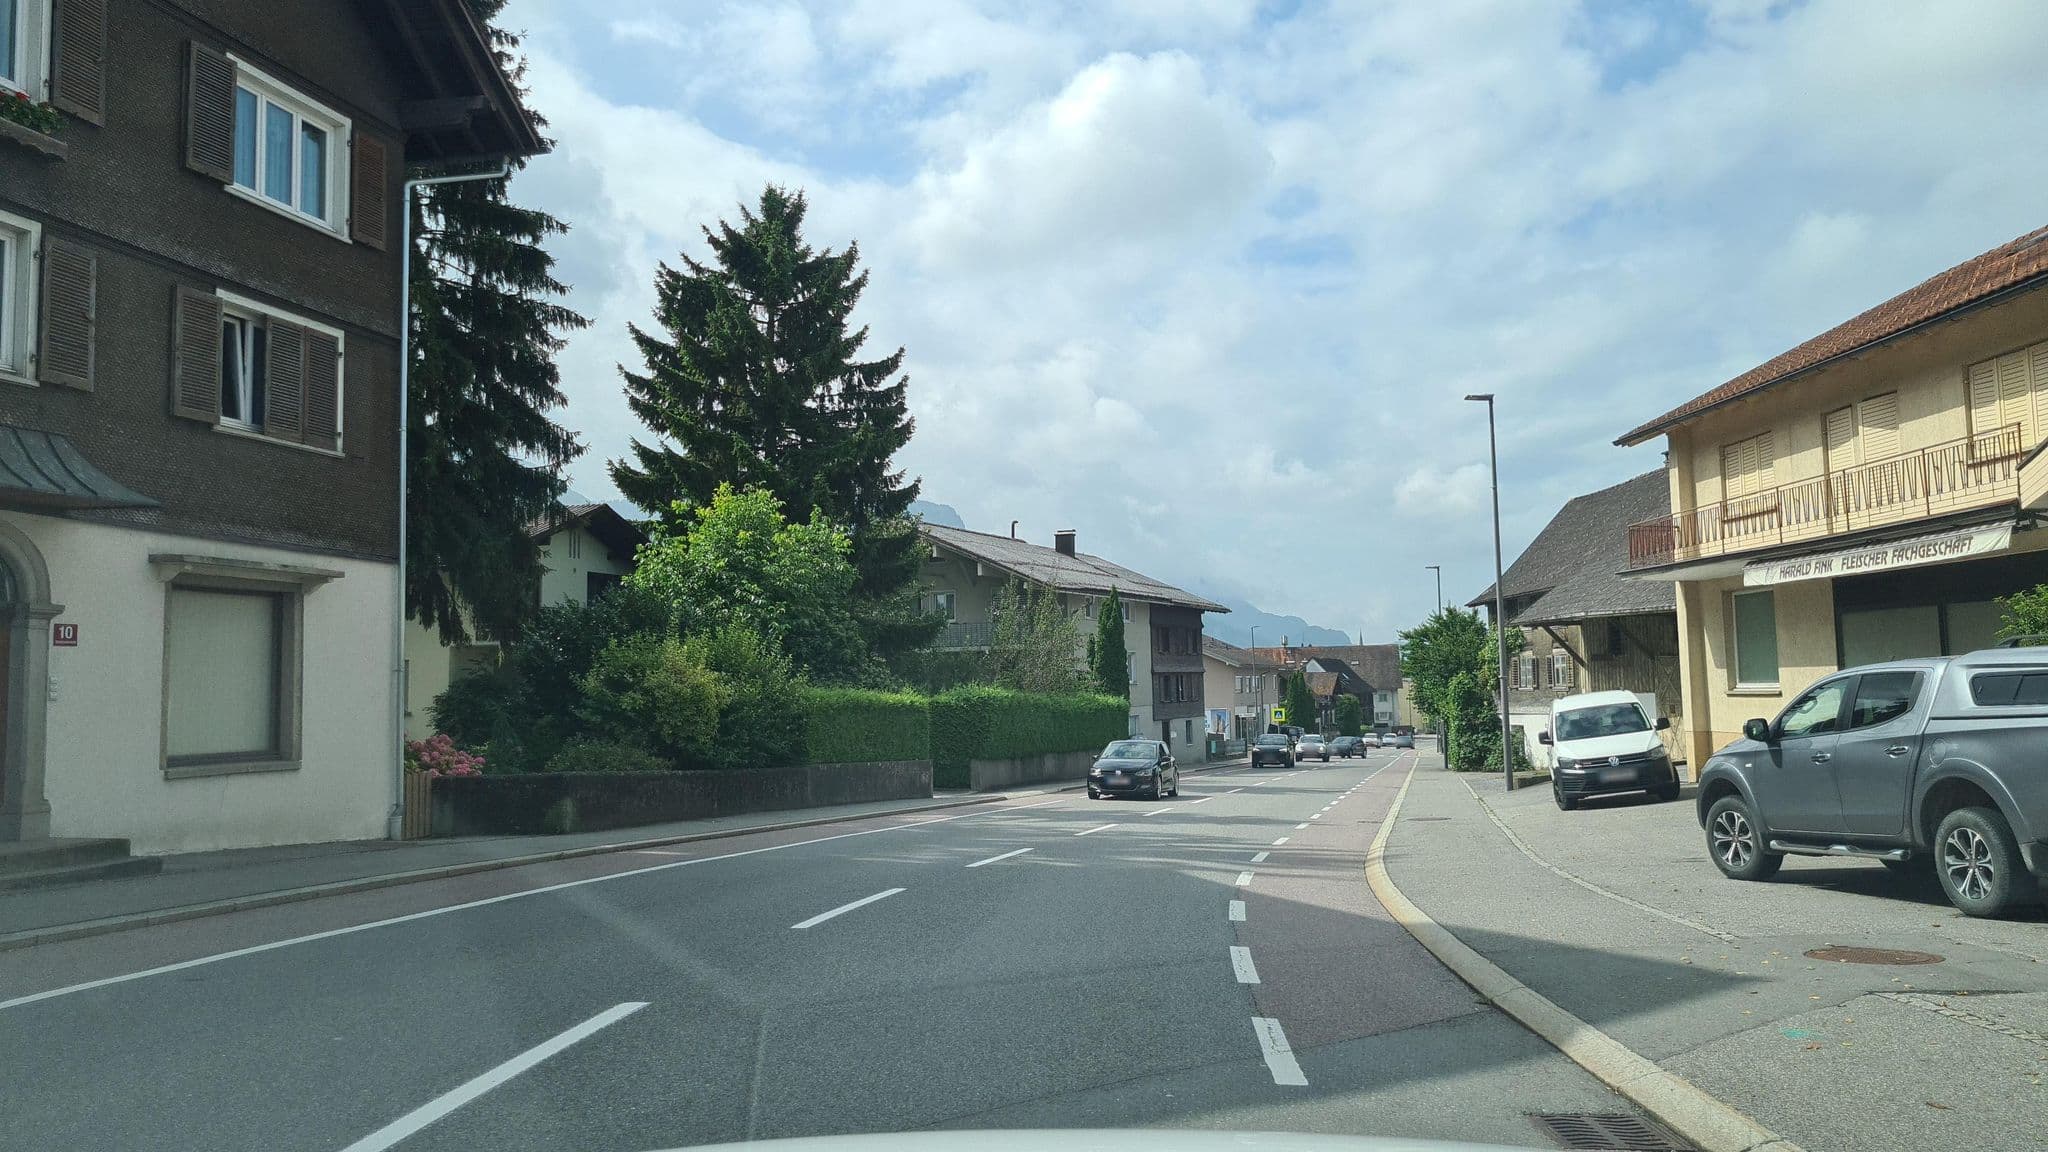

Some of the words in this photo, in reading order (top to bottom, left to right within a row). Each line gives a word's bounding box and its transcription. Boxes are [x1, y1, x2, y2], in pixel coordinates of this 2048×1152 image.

[1780, 562, 1811, 579] HARALD
[1813, 559, 1834, 575] FINK
[1840, 551, 1888, 571] FLEISCHER
[1892, 535, 1973, 563] FACHGESCHÄFT
[59, 626, 73, 639] 10
